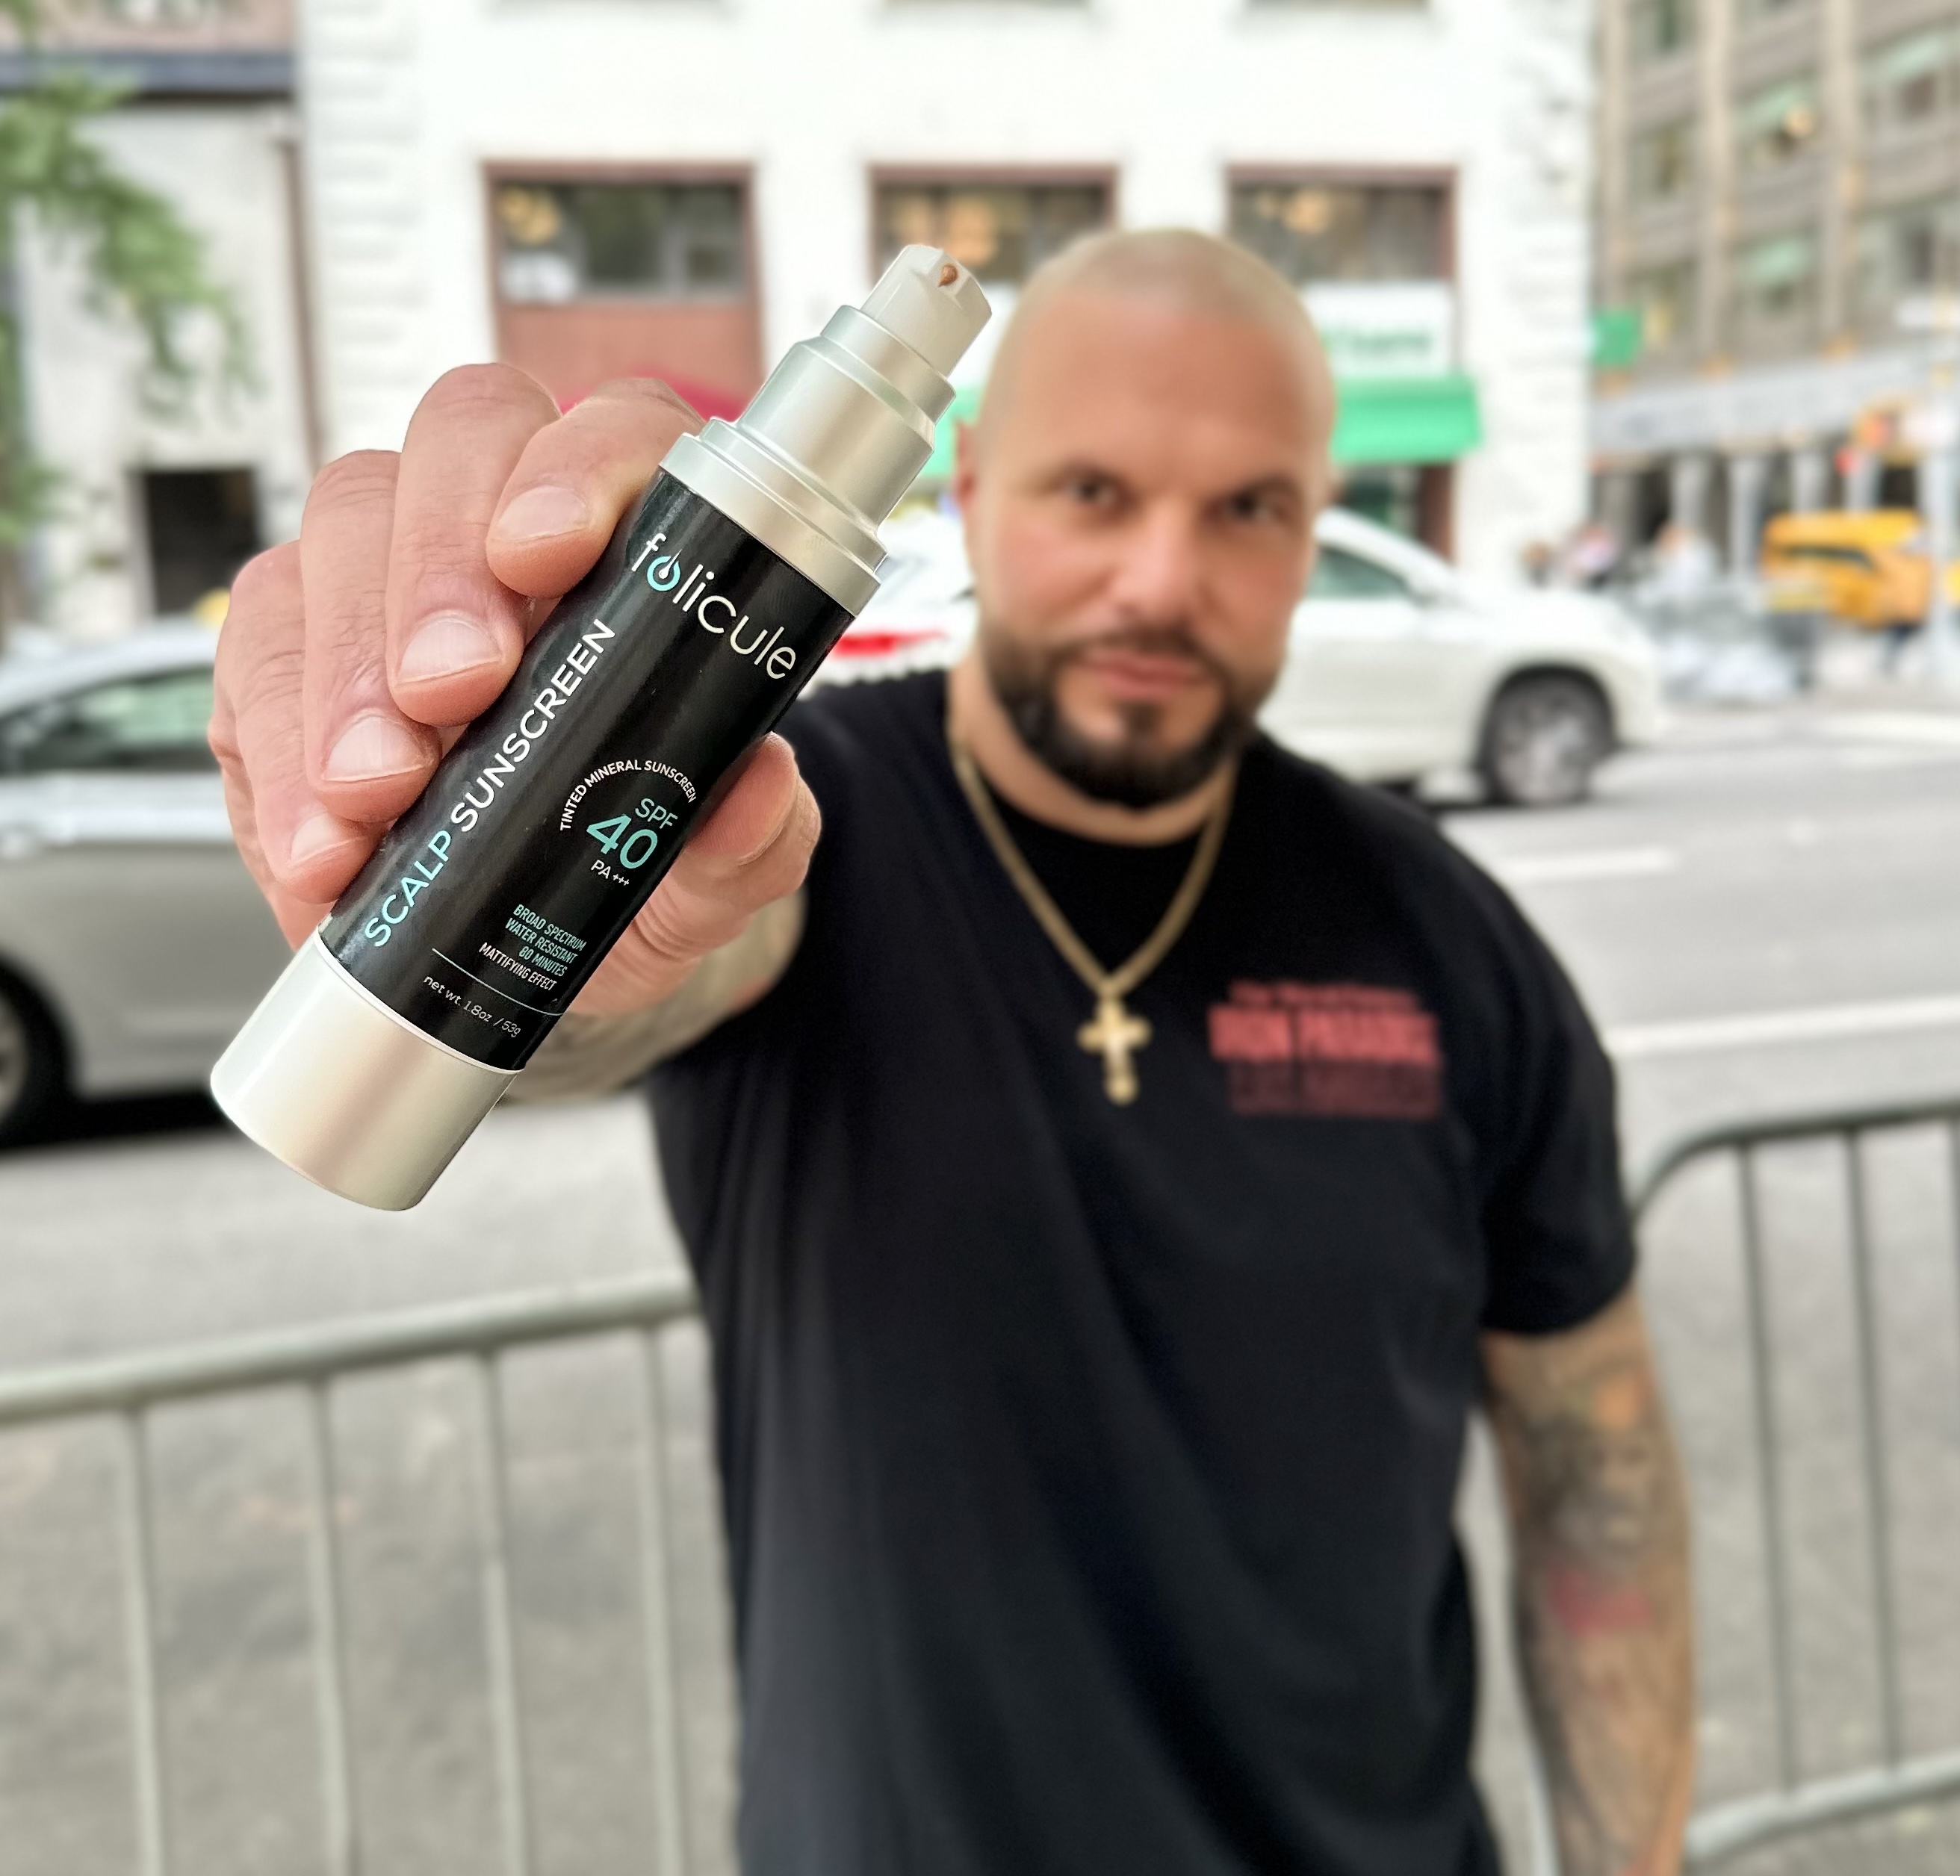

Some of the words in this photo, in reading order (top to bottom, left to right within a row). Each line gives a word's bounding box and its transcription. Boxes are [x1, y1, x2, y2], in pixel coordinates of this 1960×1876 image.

[631, 532, 797, 680] folicule
[365, 830, 453, 947] SCALP
[450, 619, 615, 833] SUNSCREEN
[560, 784, 587, 830] TINTED
[583, 760, 642, 787] MINERAL
[644, 760, 697, 804] SUNSCREEN
[635, 798, 678, 829] SPF
[586, 813, 658, 869] 40
[505, 917, 537, 944] WATER
[536, 937, 578, 964] RESISTANT
[512, 904, 547, 930] BROAD
[544, 923, 587, 951] SPECTRUM
[479, 942, 530, 979] MATTIFYING
[527, 972, 557, 991] EFFECT
[518, 945, 533, 960] 80
[531, 953, 568, 977] MINUTES
[423, 975, 446, 994] net
[463, 1000, 491, 1022] 1.8oz
